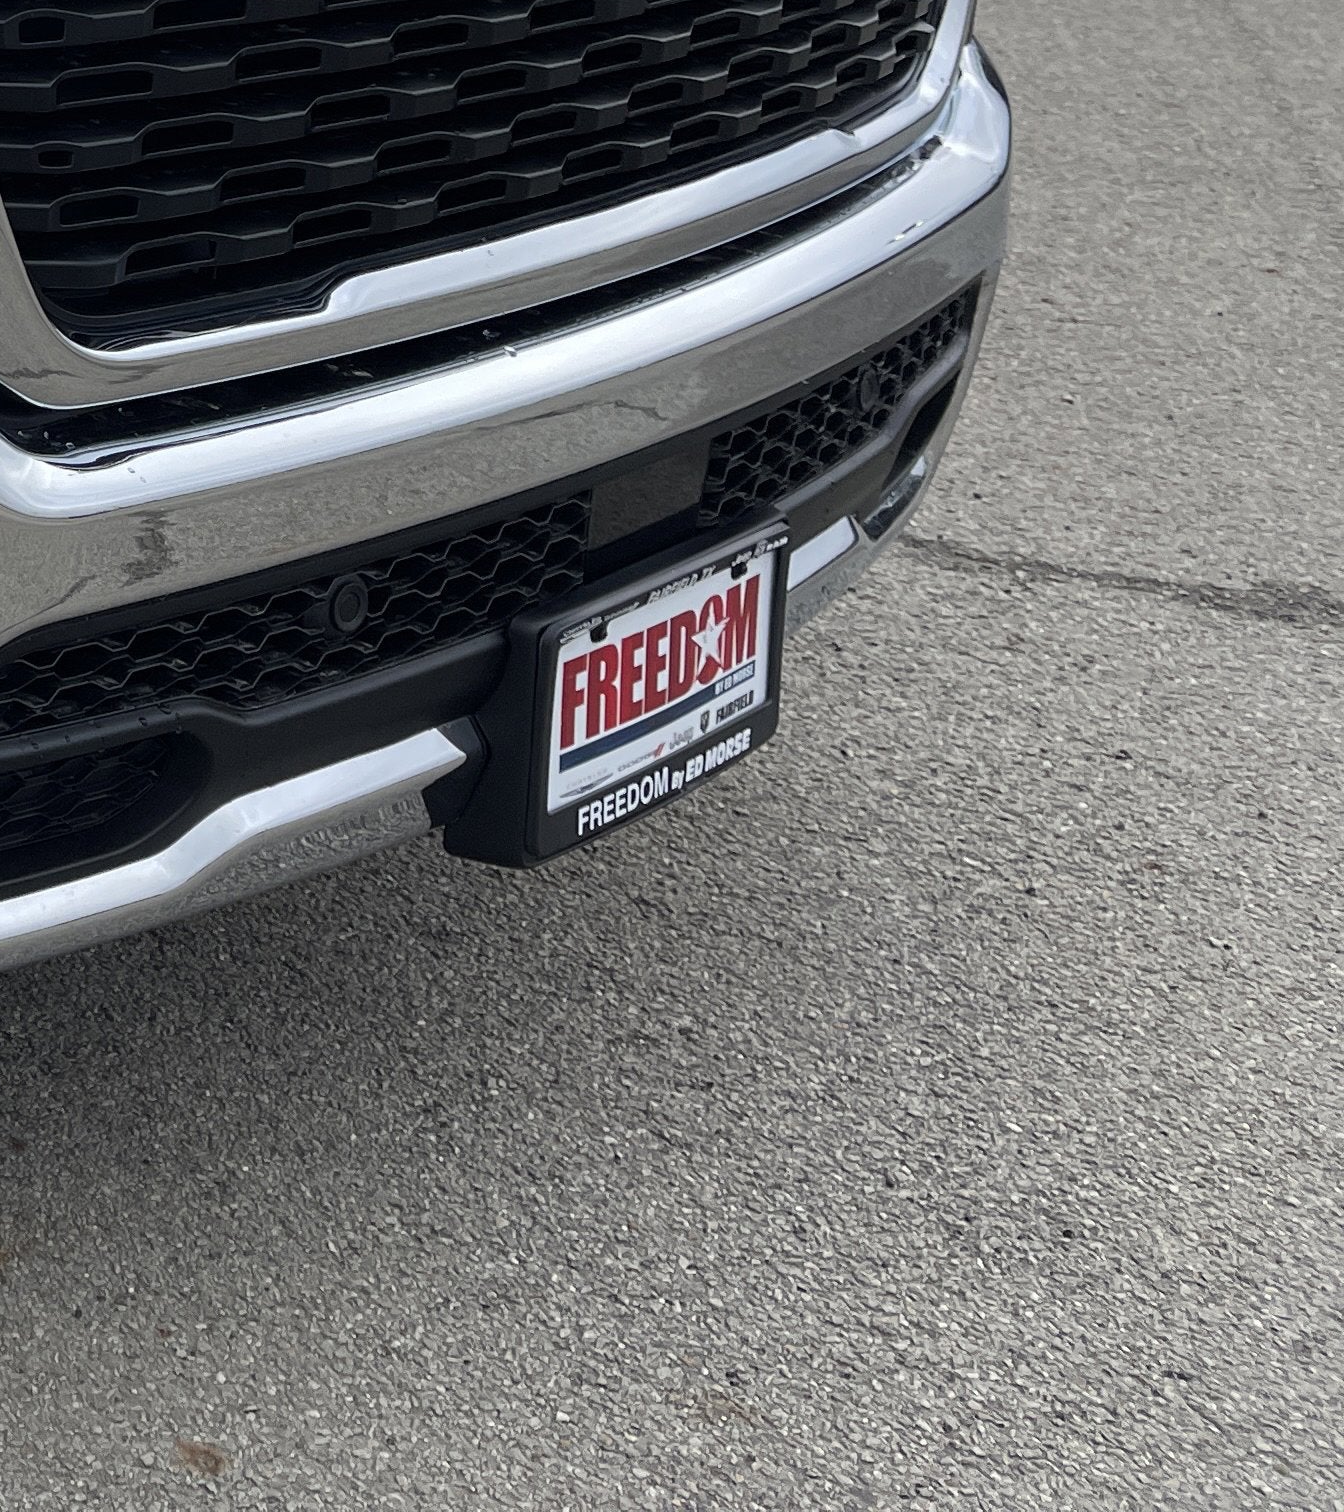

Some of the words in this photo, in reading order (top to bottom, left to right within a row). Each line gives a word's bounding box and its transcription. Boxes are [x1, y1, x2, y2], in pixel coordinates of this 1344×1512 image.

[560, 574, 760, 750] FREEDOM
[577, 766, 669, 836] FREEDOM
[685, 754, 704, 782] ED
[704, 728, 752, 772] MORSE
